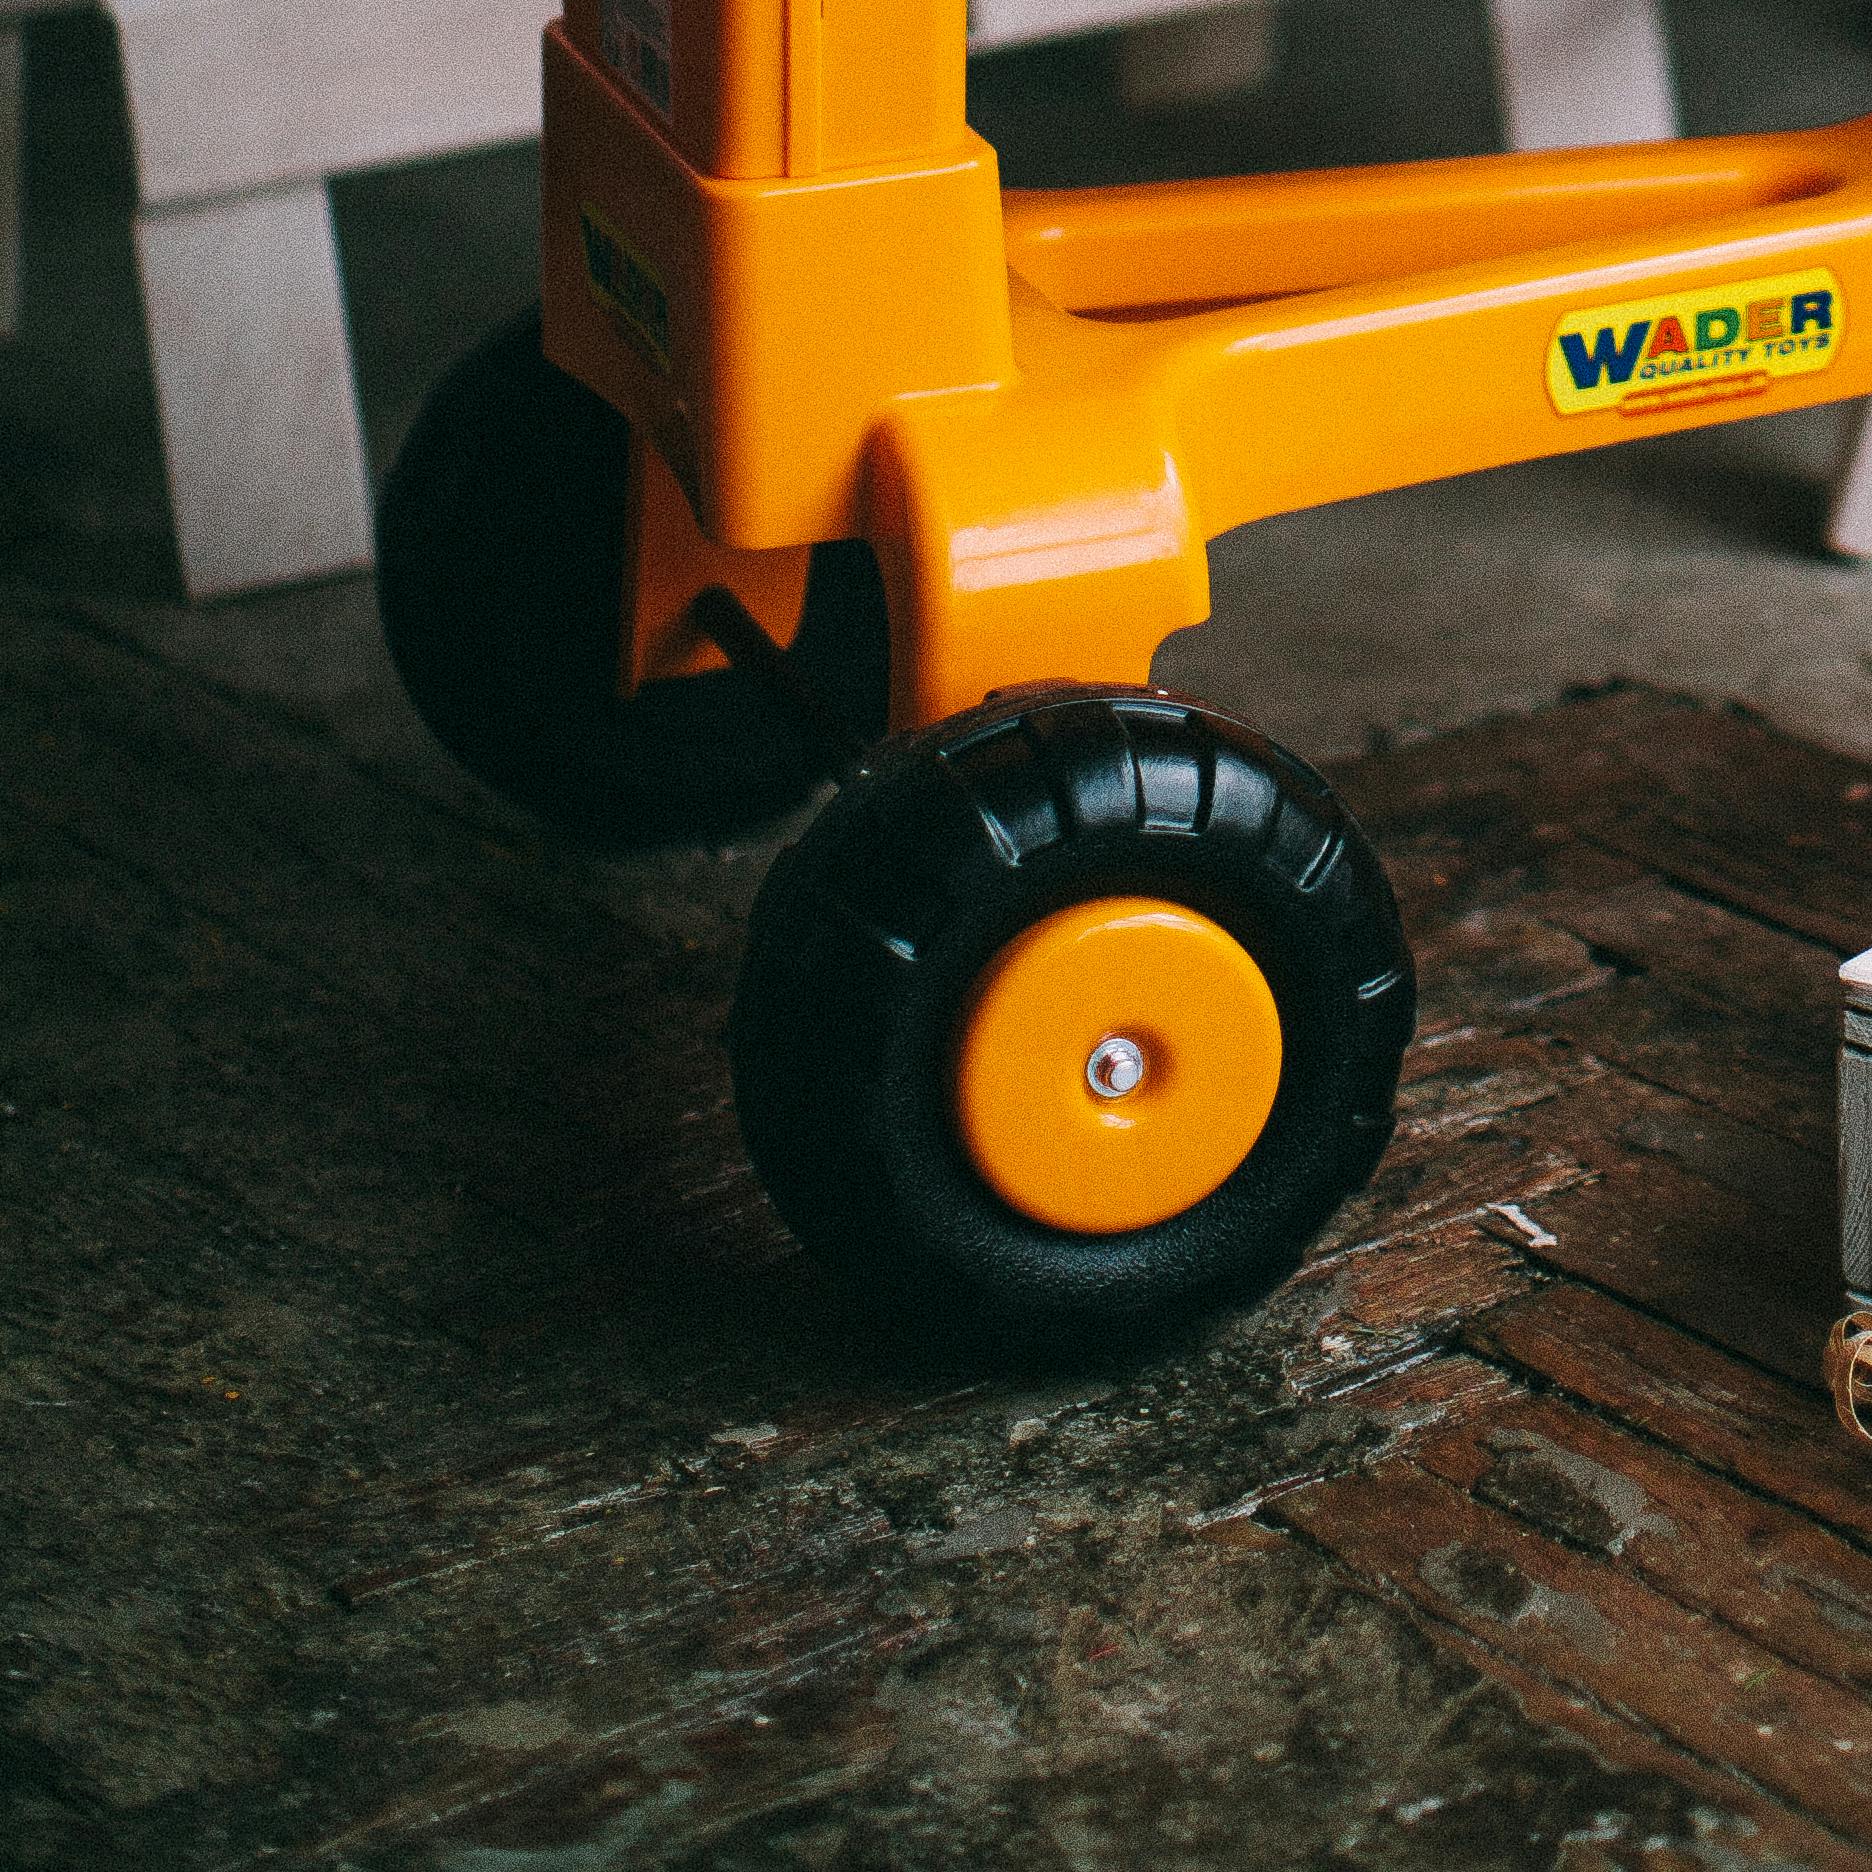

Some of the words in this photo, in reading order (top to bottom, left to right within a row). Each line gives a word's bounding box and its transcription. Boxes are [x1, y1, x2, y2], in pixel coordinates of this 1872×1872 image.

[1558, 290, 1833, 390] WADER
[1639, 348, 1750, 380] QUALITY
[1763, 332, 1831, 359] TOYS
